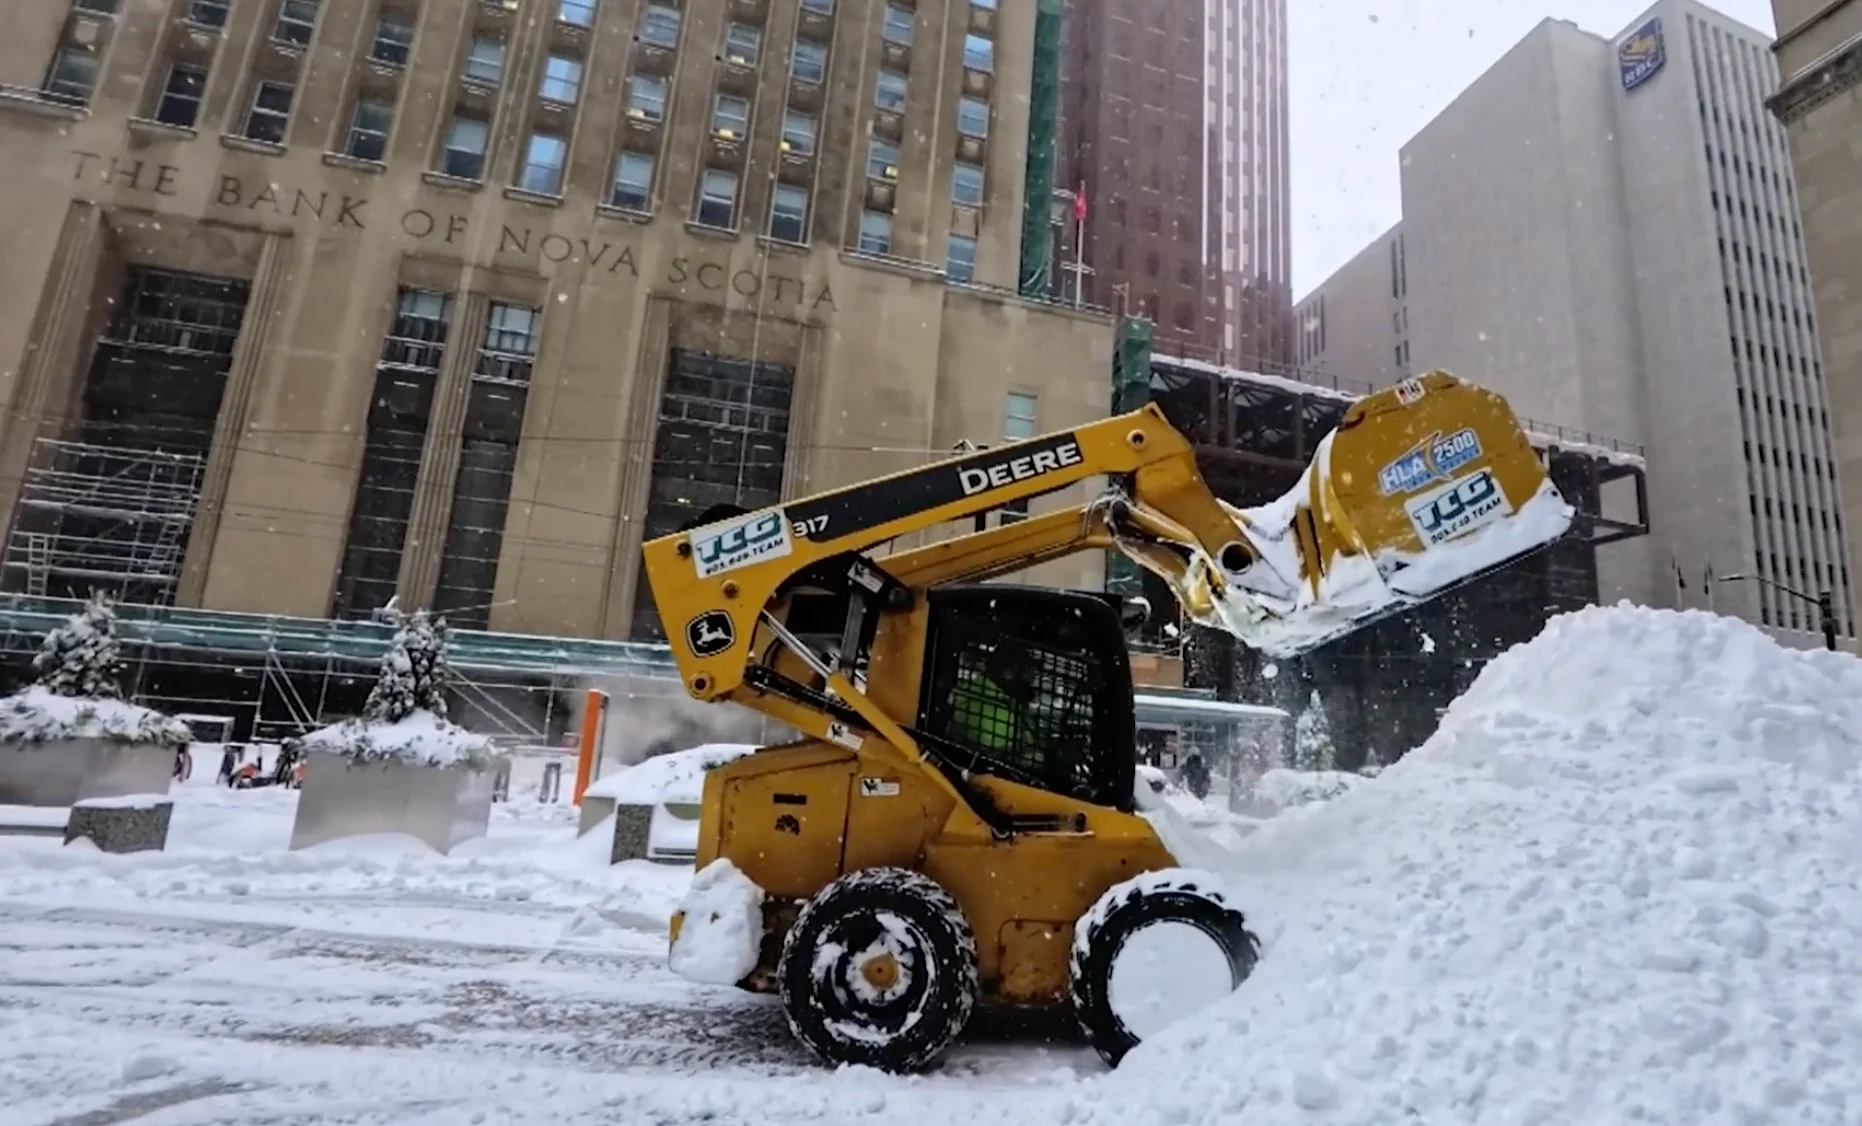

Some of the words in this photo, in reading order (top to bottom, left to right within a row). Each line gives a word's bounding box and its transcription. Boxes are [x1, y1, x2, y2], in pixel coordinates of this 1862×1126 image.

[70, 150, 180, 196] THE
[216, 175, 369, 229] BANK
[401, 208, 469, 244] OF
[500, 225, 639, 277] NOVA
[667, 256, 839, 312] SCOTIA
[1433, 431, 1475, 463] 2500
[960, 441, 1082, 496] DEERE
[1381, 456, 1428, 491] HLA
[792, 514, 829, 538] 317
